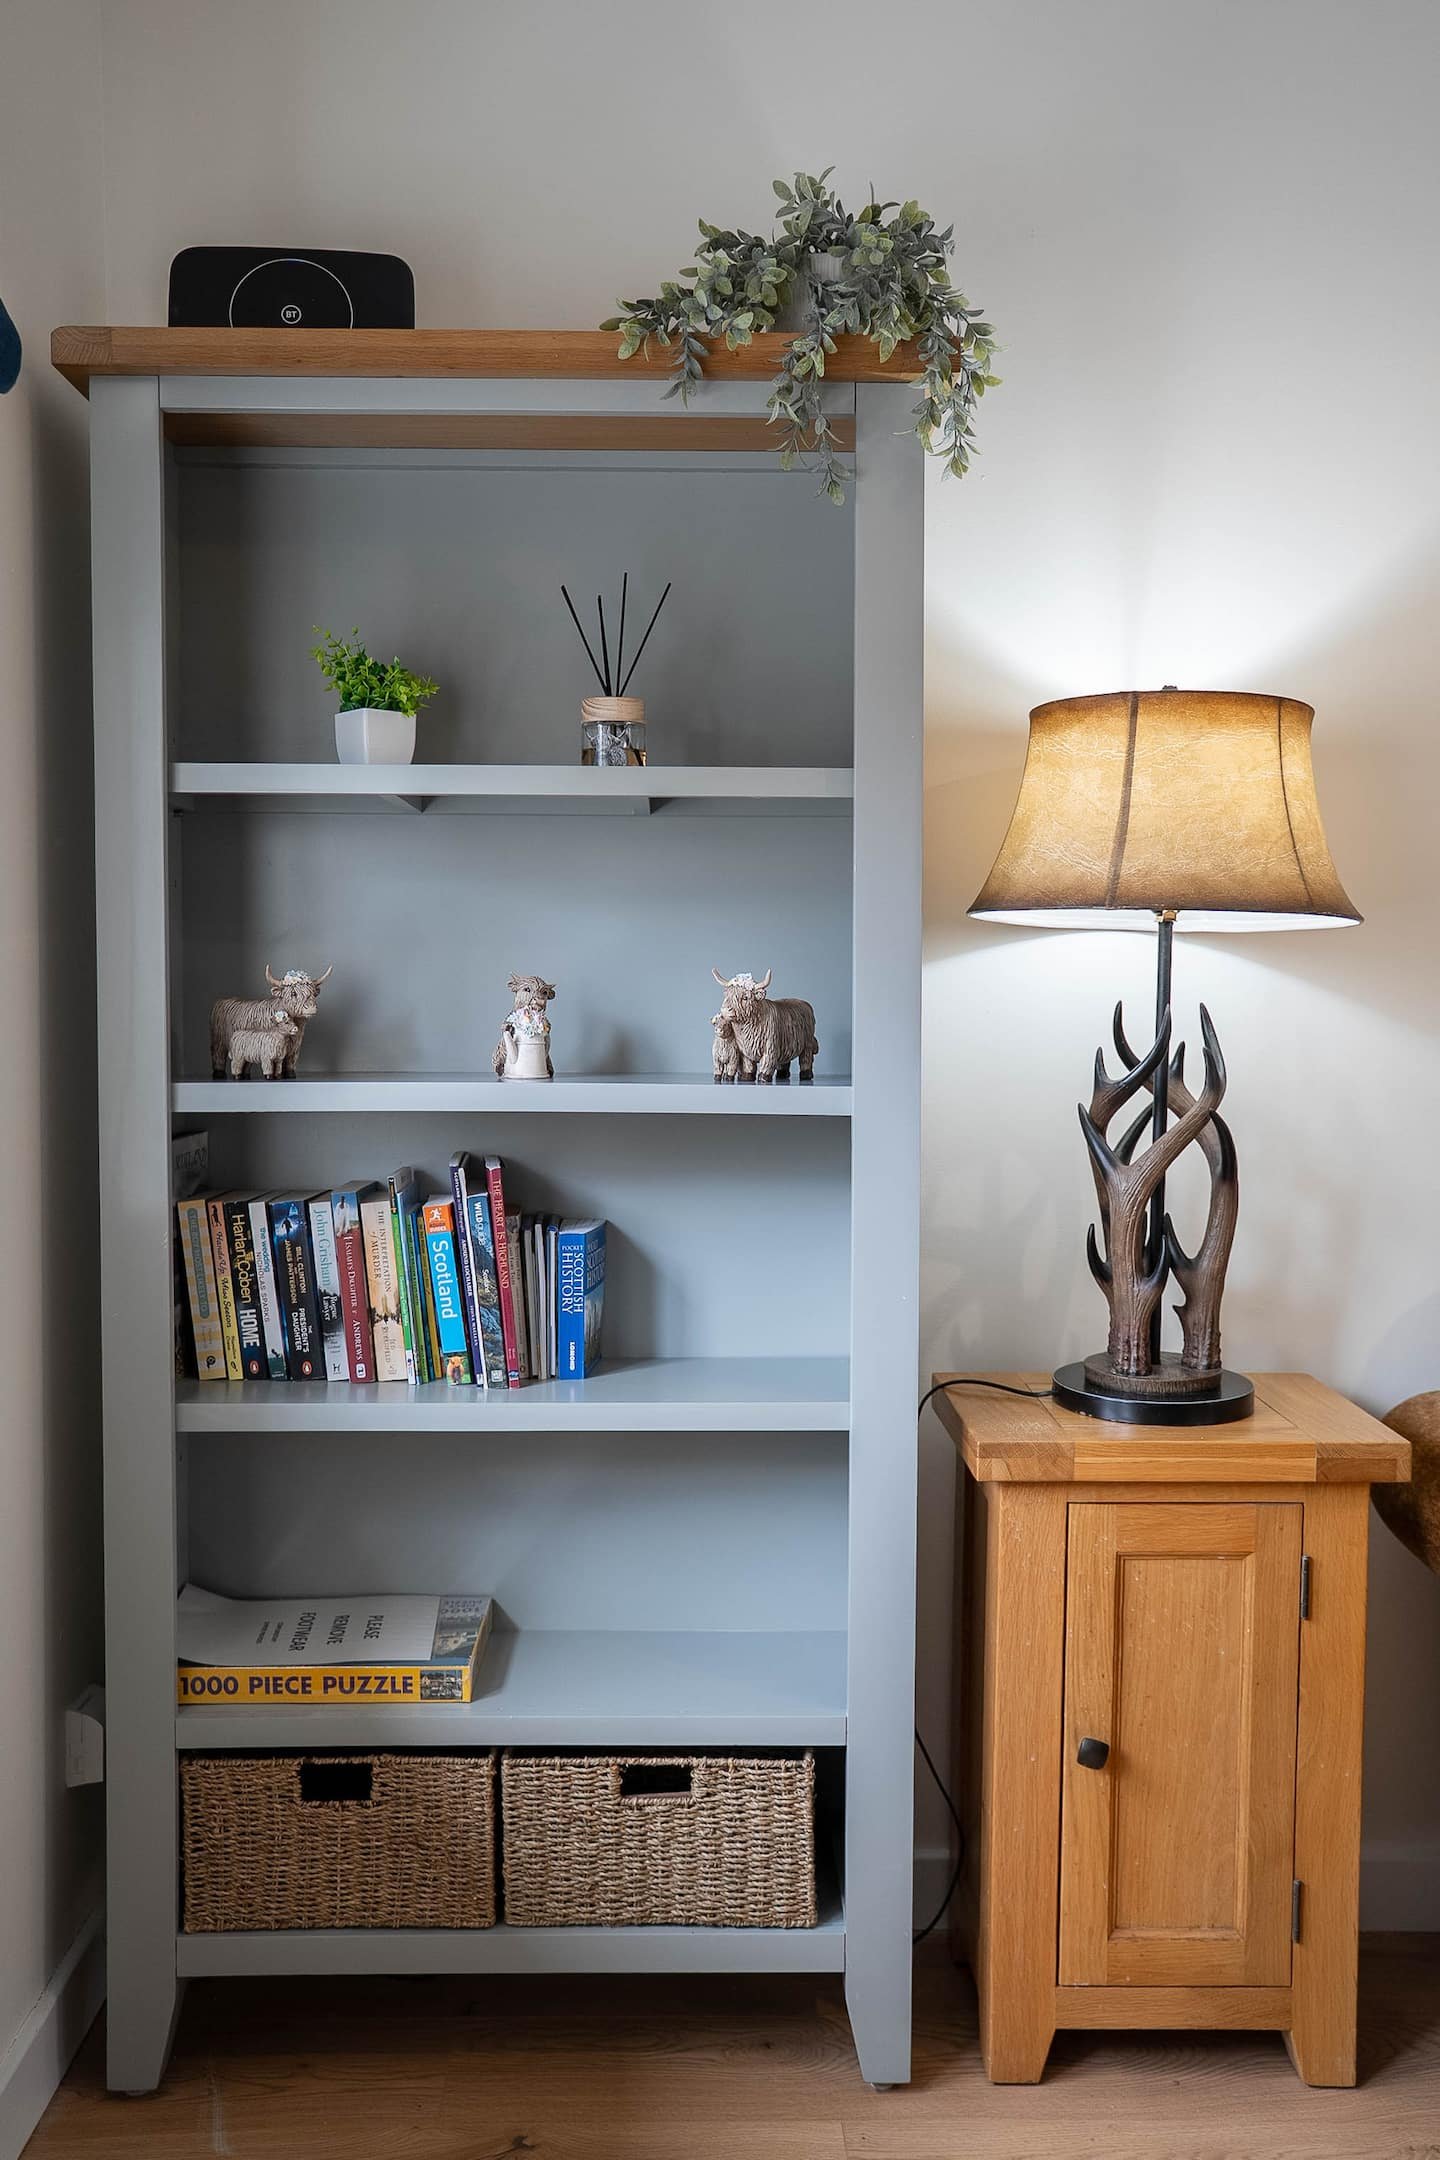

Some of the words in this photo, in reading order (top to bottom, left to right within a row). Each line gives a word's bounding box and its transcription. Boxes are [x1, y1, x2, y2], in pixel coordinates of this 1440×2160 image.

[286, 310, 297, 318] BT
[492, 1179, 502, 1196] THE
[313, 1209, 328, 1236] John
[377, 1211, 385, 1224] THE
[495, 1200, 504, 1227] HEART
[232, 1214, 247, 1258] Harlan
[284, 1240, 293, 1262] JAMES
[370, 1231, 379, 1239] of
[496, 1231, 505, 1240] IS
[261, 1240, 271, 1273] wedding
[318, 1238, 332, 1286] Grisham
[371, 1240, 382, 1280] MURDER
[379, 1228, 392, 1292] INTERPRETATION
[461, 1239, 469, 1265] AROUND
[498, 1242, 509, 1289] HIGHLAND
[221, 1277, 230, 1299] Miss
[237, 1260, 252, 1304] Coben
[256, 1251, 266, 1291] NICHOLAS
[261, 1293, 270, 1322] SPARKS
[287, 1262, 298, 1304] PATTERSON
[297, 1262, 307, 1294] CLINTON
[347, 1270, 358, 1308] DAUGHTER
[433, 1239, 459, 1320] Scotland
[464, 1265, 473, 1297] LOCHABER
[482, 1269, 492, 1293] Scotland
[562, 1252, 574, 1314] HISTORY
[573, 1252, 584, 1313] SCOTTISH
[223, 1300, 232, 1328] Seeton
[322, 1295, 331, 1321] Lawyer
[328, 1295, 338, 1319] Rogue
[240, 1308, 260, 1349] HOME
[291, 1311, 302, 1351] DAUGHTER
[299, 1307, 310, 1353] PRESIDENT'S
[352, 1319, 363, 1361] ANDREWS
[288, 1612, 317, 1651] FOOTWEAR
[326, 1615, 350, 1645] REMOVE
[363, 1615, 384, 1639] PLEASE
[180, 1676, 239, 1696] 1000
[249, 1676, 312, 1695] PIECE
[323, 1676, 413, 1695] PUZZLE
